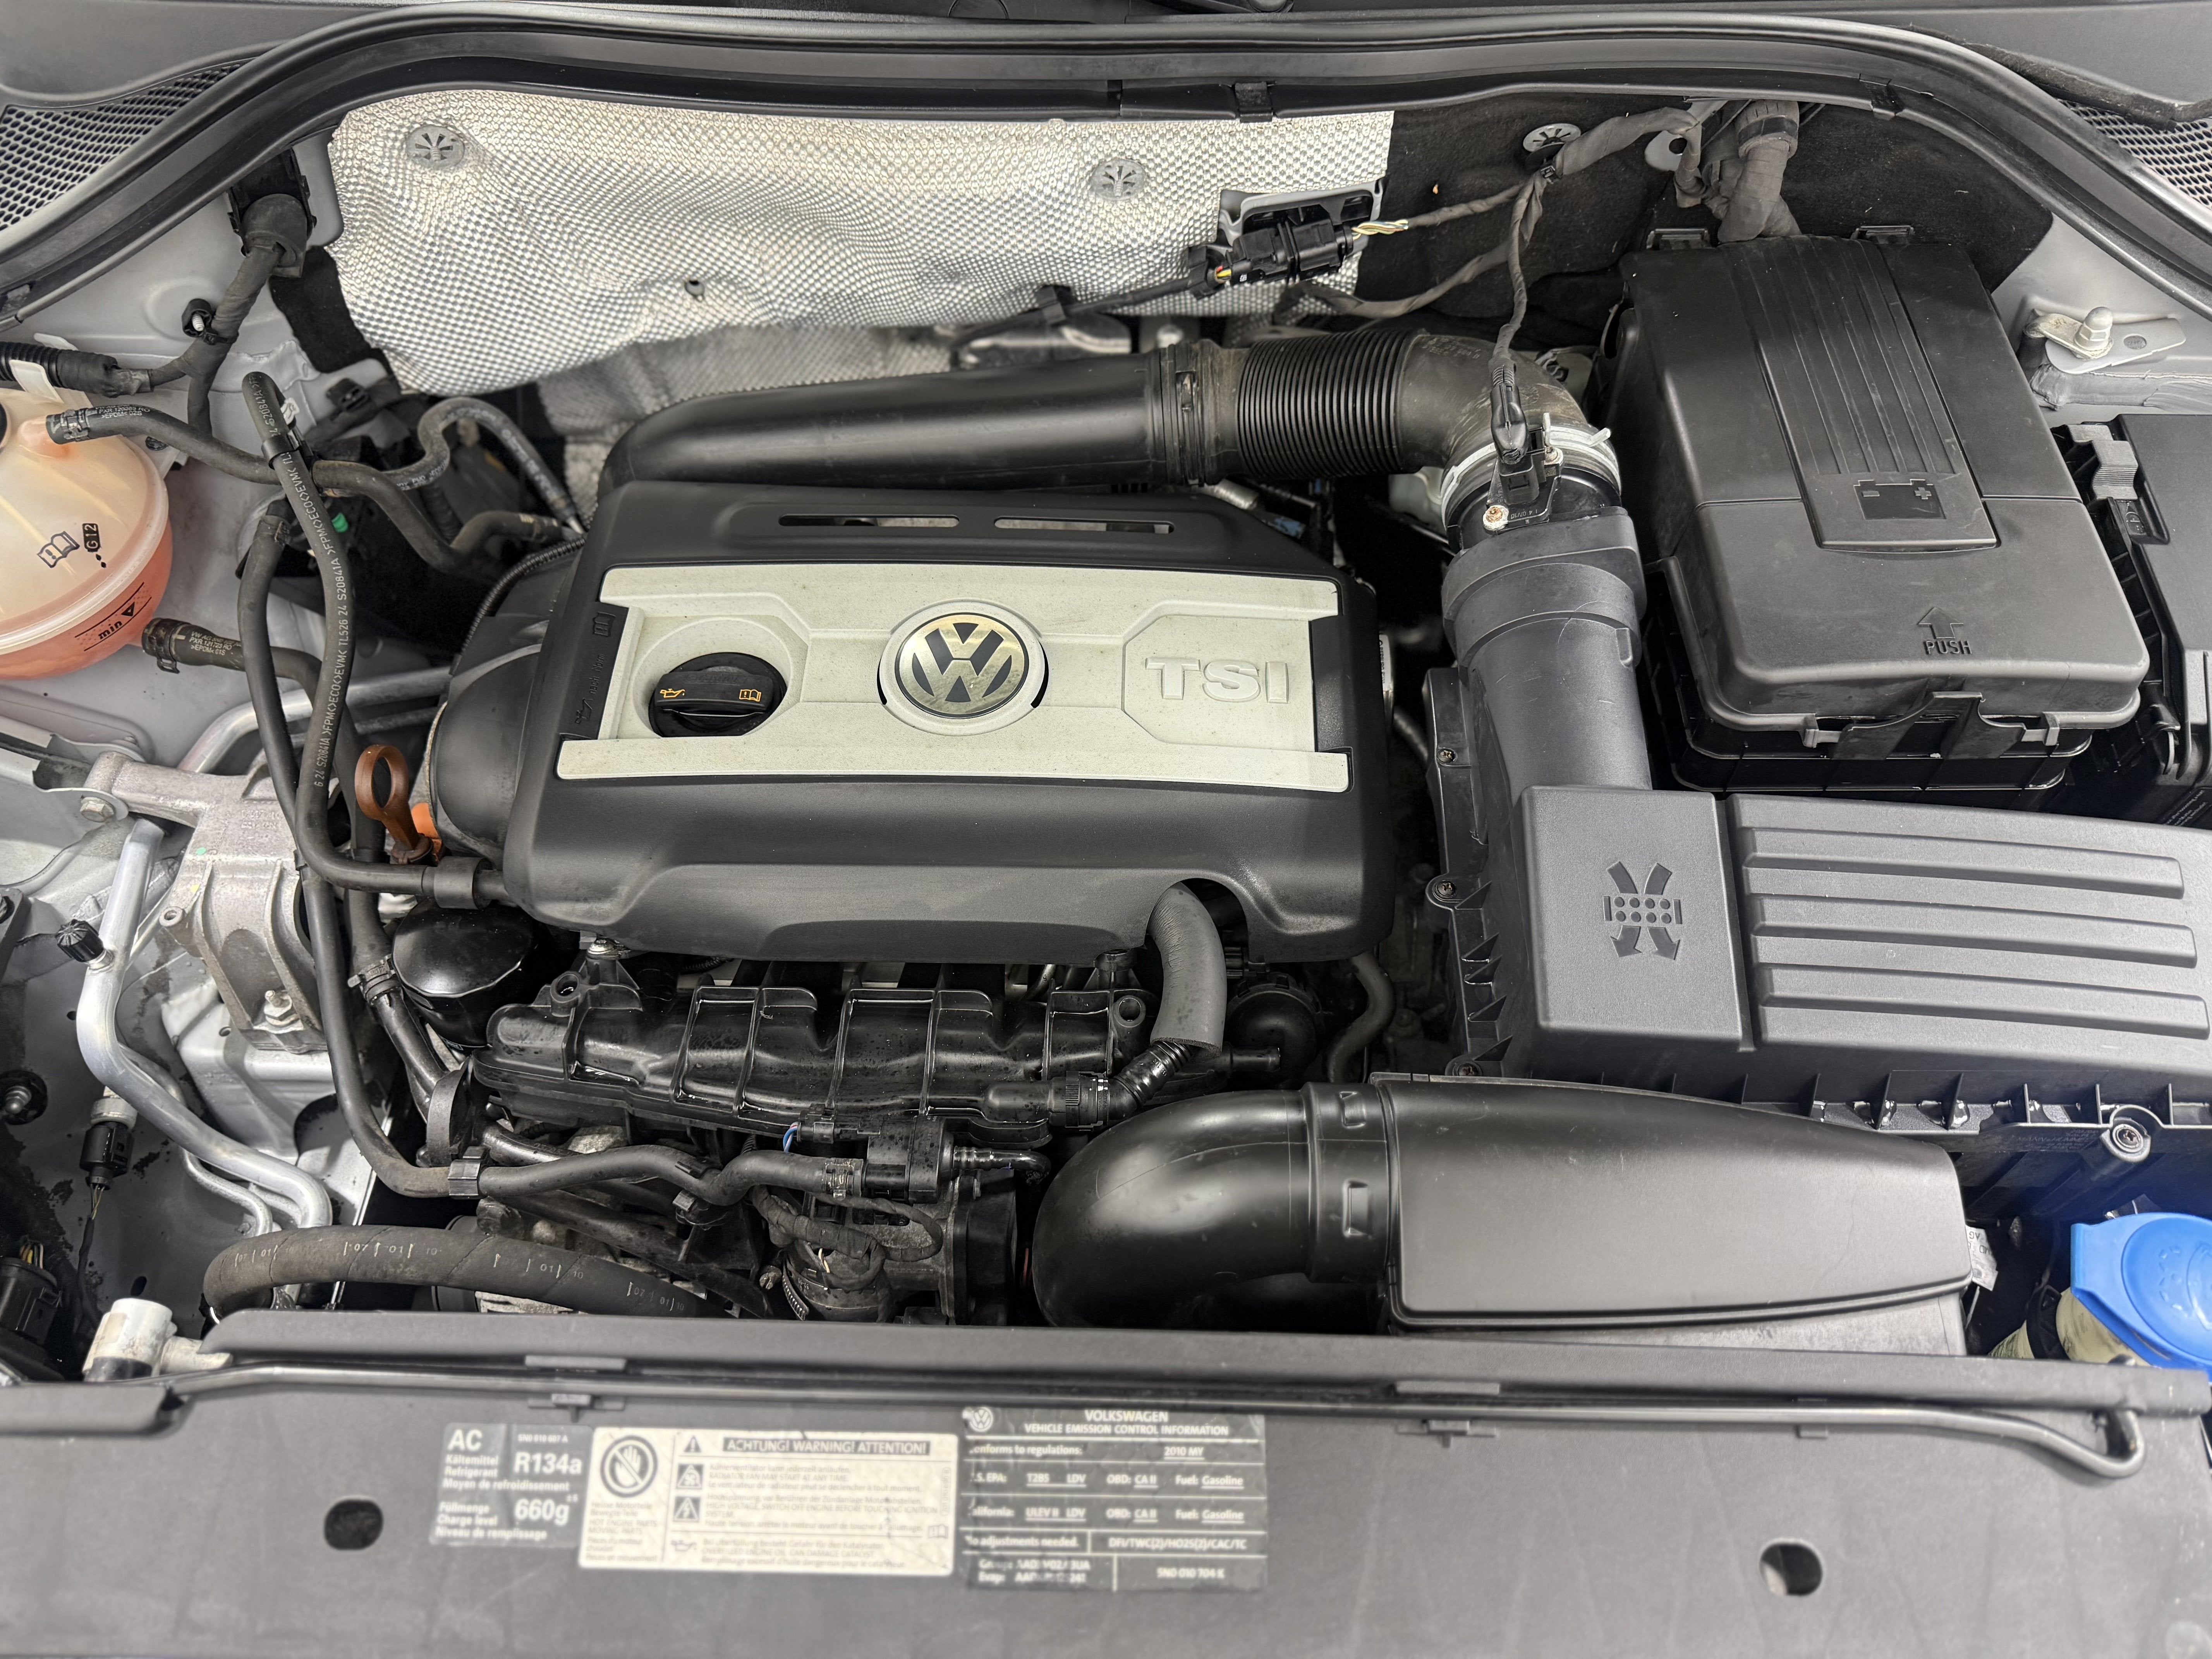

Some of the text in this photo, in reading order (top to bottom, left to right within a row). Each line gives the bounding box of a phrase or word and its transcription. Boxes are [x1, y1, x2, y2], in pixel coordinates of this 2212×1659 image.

[338, 605, 348, 616] 24
[98, 620, 123, 640] min
[338, 619, 349, 646] TL526
[189, 637, 203, 645] PXR
[1923, 639, 1973, 655] PUSH
[895, 612, 1029, 719] VW
[588, 653, 606, 695] nach Norm
[1144, 656, 1290, 704] TSI
[1085, 1410, 1169, 1423] VOLKSWAGEN
[1024, 1423, 1229, 1436] VEHICLE EMISSION CONTROL INFORMATION
[447, 1429, 483, 1452] AC
[534, 1434, 547, 1443] 010
[562, 1435, 568, 1444] A
[726, 1438, 927, 1455] ACHTUNG! WARNING! ATTENTION!
[1015, 1444, 1204, 1457] to regulations: 2010 MY
[445, 1453, 499, 1466] Kältemittel
[514, 1451, 582, 1475] R134a
[444, 1465, 498, 1479] Refrigerant
[986, 1472, 1008, 1483] EPA:
[1027, 1473, 1050, 1483] T2B5
[1066, 1474, 1087, 1483] LDV
[1106, 1474, 1132, 1484] OBD:
[1134, 1474, 1148, 1484] CA
[1175, 1475, 1199, 1485] Fuel:
[1202, 1475, 1244, 1486] Gasoline
[442, 1479, 570, 1492] Moyen de refroidissement
[438, 1501, 489, 1515] Füllmenge
[514, 1498, 570, 1527] 660g
[904, 1506, 938, 1514] IGNITION
[1026, 1508, 1051, 1518] ULEV
[1066, 1508, 1087, 1518] LDV
[1106, 1509, 1132, 1518] OBD:
[1134, 1509, 1148, 1519] CA
[1175, 1509, 1199, 1520] Fuel:
[1202, 1510, 1244, 1520] Gasoline
[436, 1513, 498, 1527] Charge level
[435, 1526, 547, 1541] Niveau de remplissage
[980, 1535, 1040, 1549] adjustments
[1041, 1536, 1080, 1548] needed.
[1178, 1568, 1196, 1579] 010
[1197, 1568, 1216, 1579] 704
[1217, 1568, 1226, 1579] K
